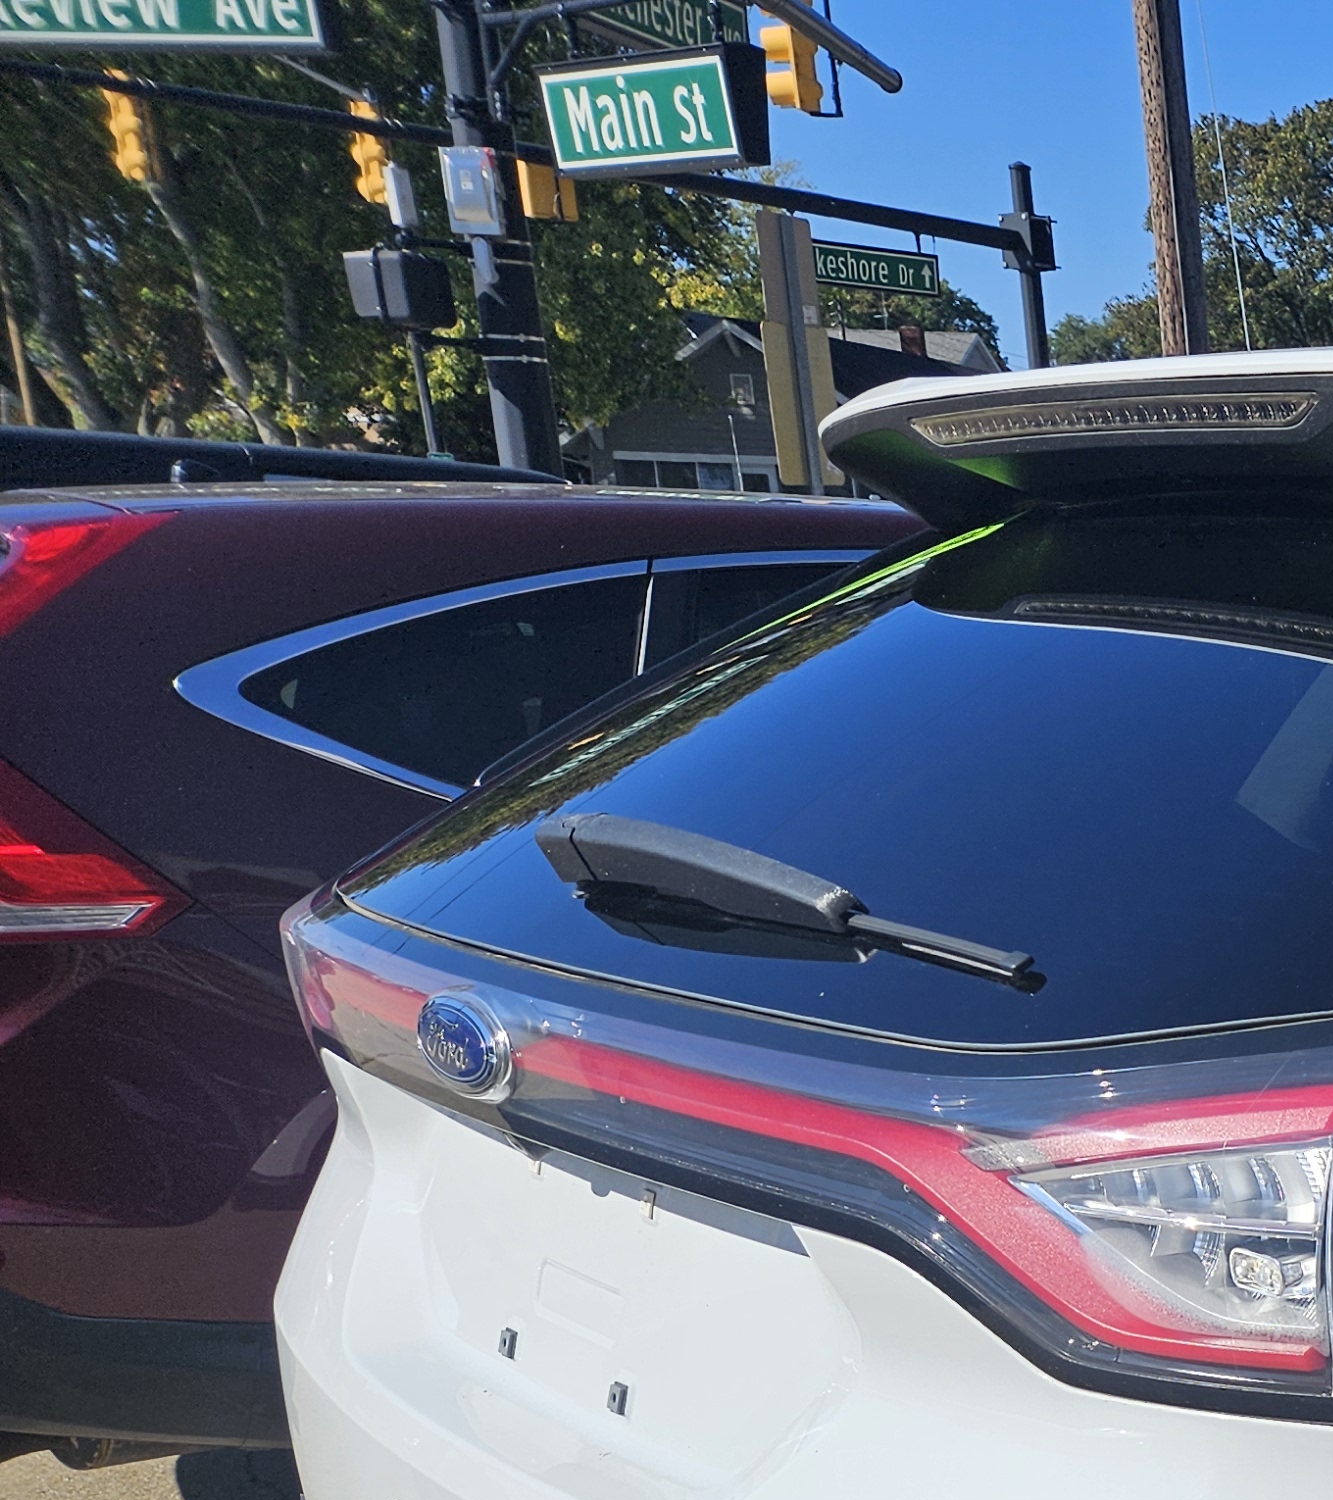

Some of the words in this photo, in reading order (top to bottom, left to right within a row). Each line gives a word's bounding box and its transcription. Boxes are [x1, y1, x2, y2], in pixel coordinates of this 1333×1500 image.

[214, 0, 303, 31] Ave
[563, 75, 663, 153] Main
[673, 82, 713, 144] St
[815, 247, 889, 284] keshore
[898, 264, 915, 287] Dr
[425, 1012, 470, 1071] Ford
